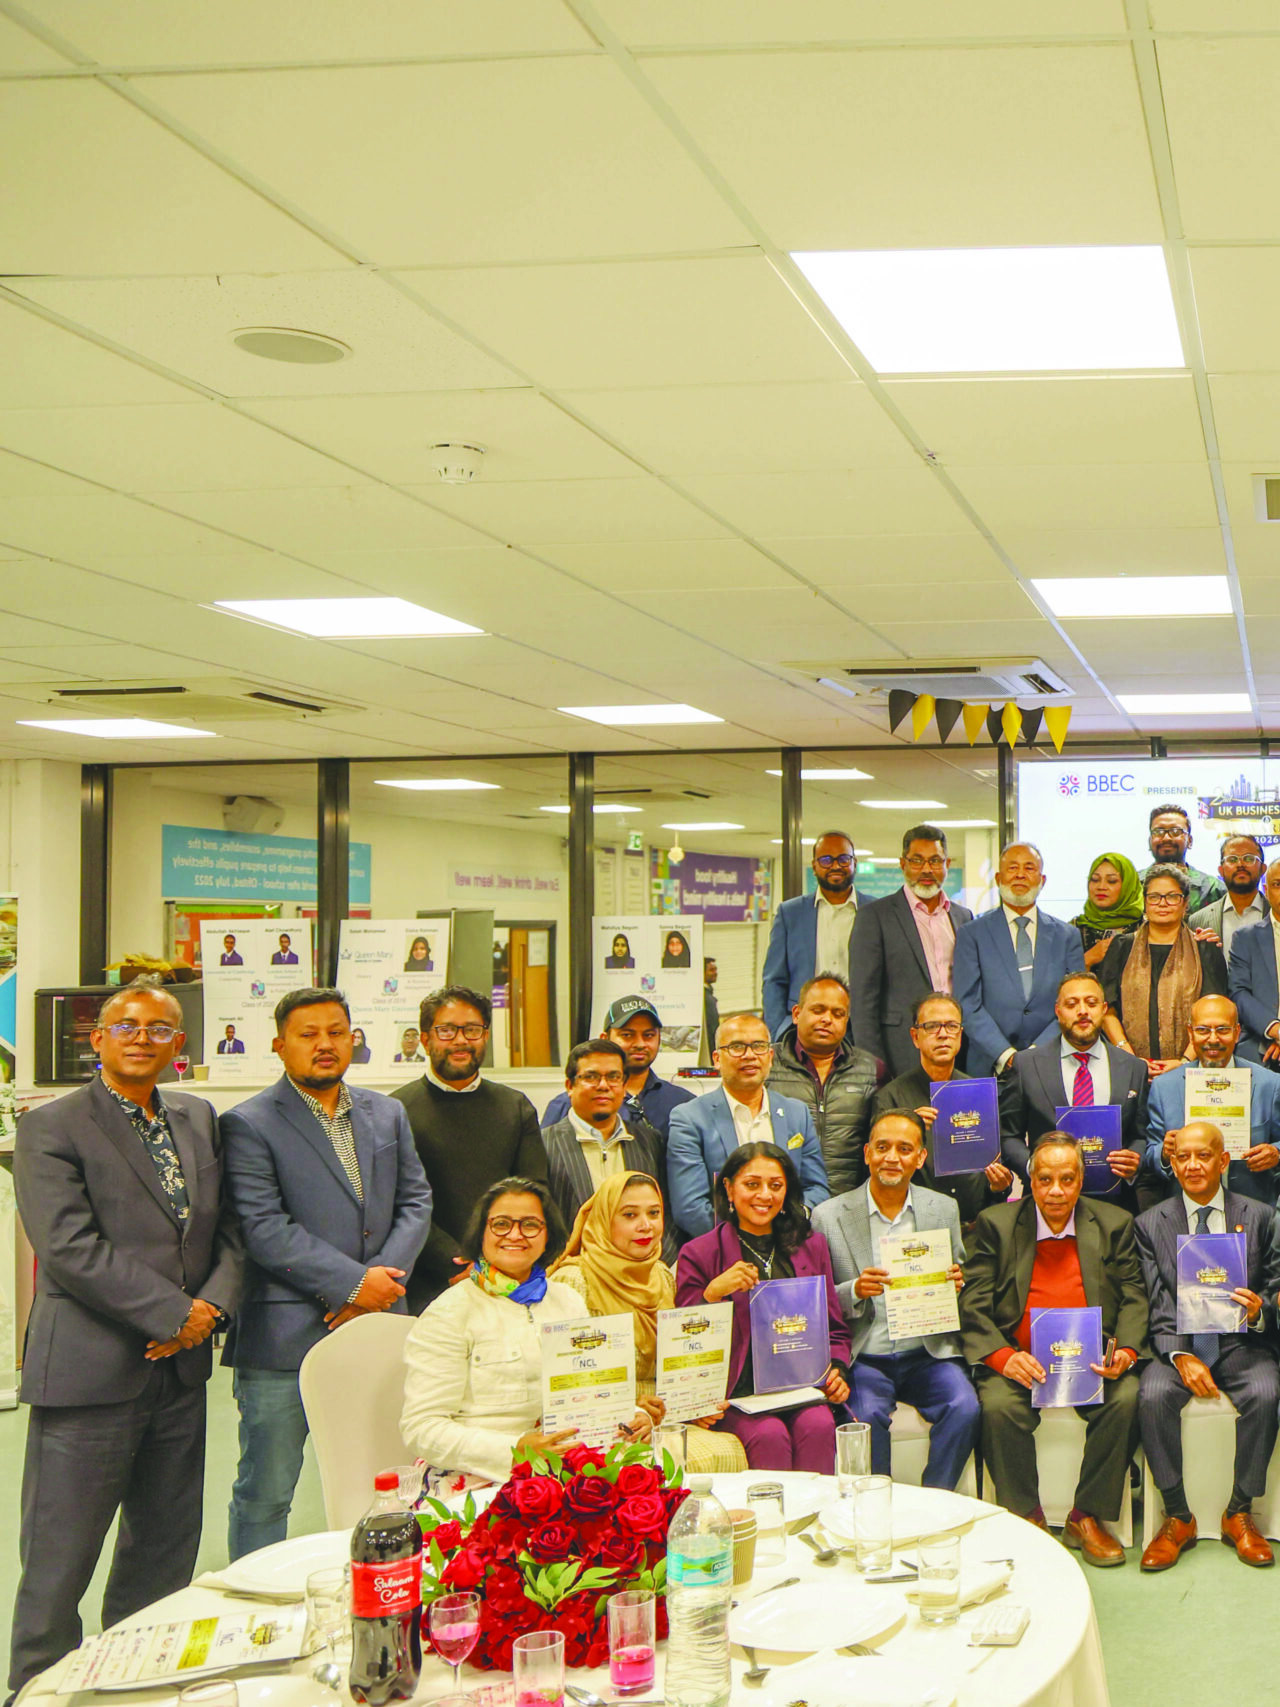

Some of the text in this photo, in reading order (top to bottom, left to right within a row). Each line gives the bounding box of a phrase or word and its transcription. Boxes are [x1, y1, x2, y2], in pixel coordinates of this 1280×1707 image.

[1087, 775, 1135, 792] BBEC
[1147, 786, 1194, 795] PRESENTS
[1218, 806, 1234, 816] UK
[688, 1342, 704, 1351] NCL
[579, 1358, 598, 1368] NCL
[373, 1575, 415, 1592] Salaam
[380, 1587, 410, 1604] Cola
